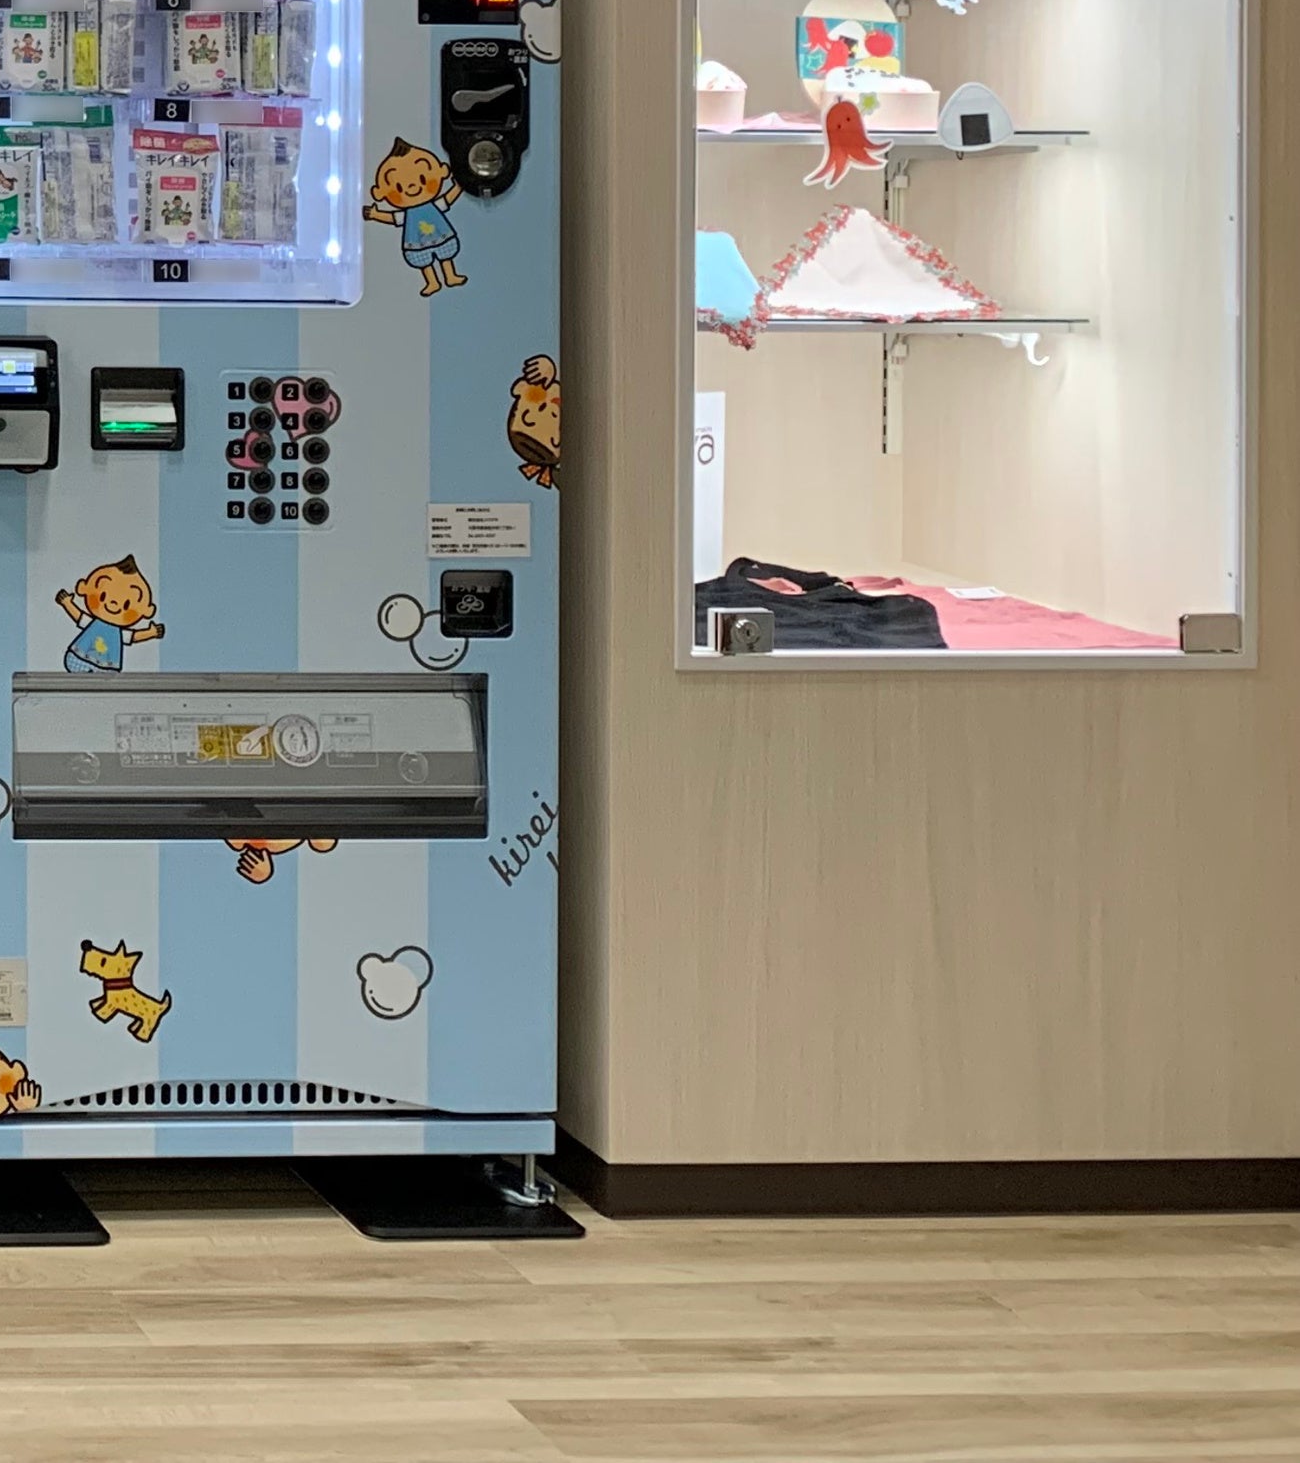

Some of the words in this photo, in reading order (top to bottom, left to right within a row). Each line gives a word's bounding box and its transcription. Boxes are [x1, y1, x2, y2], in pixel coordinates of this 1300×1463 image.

[165, 103, 178, 119] 8
[146, 154, 210, 167] キレイキレイ
[159, 263, 182, 279] 10
[487, 790, 558, 888] kirei
